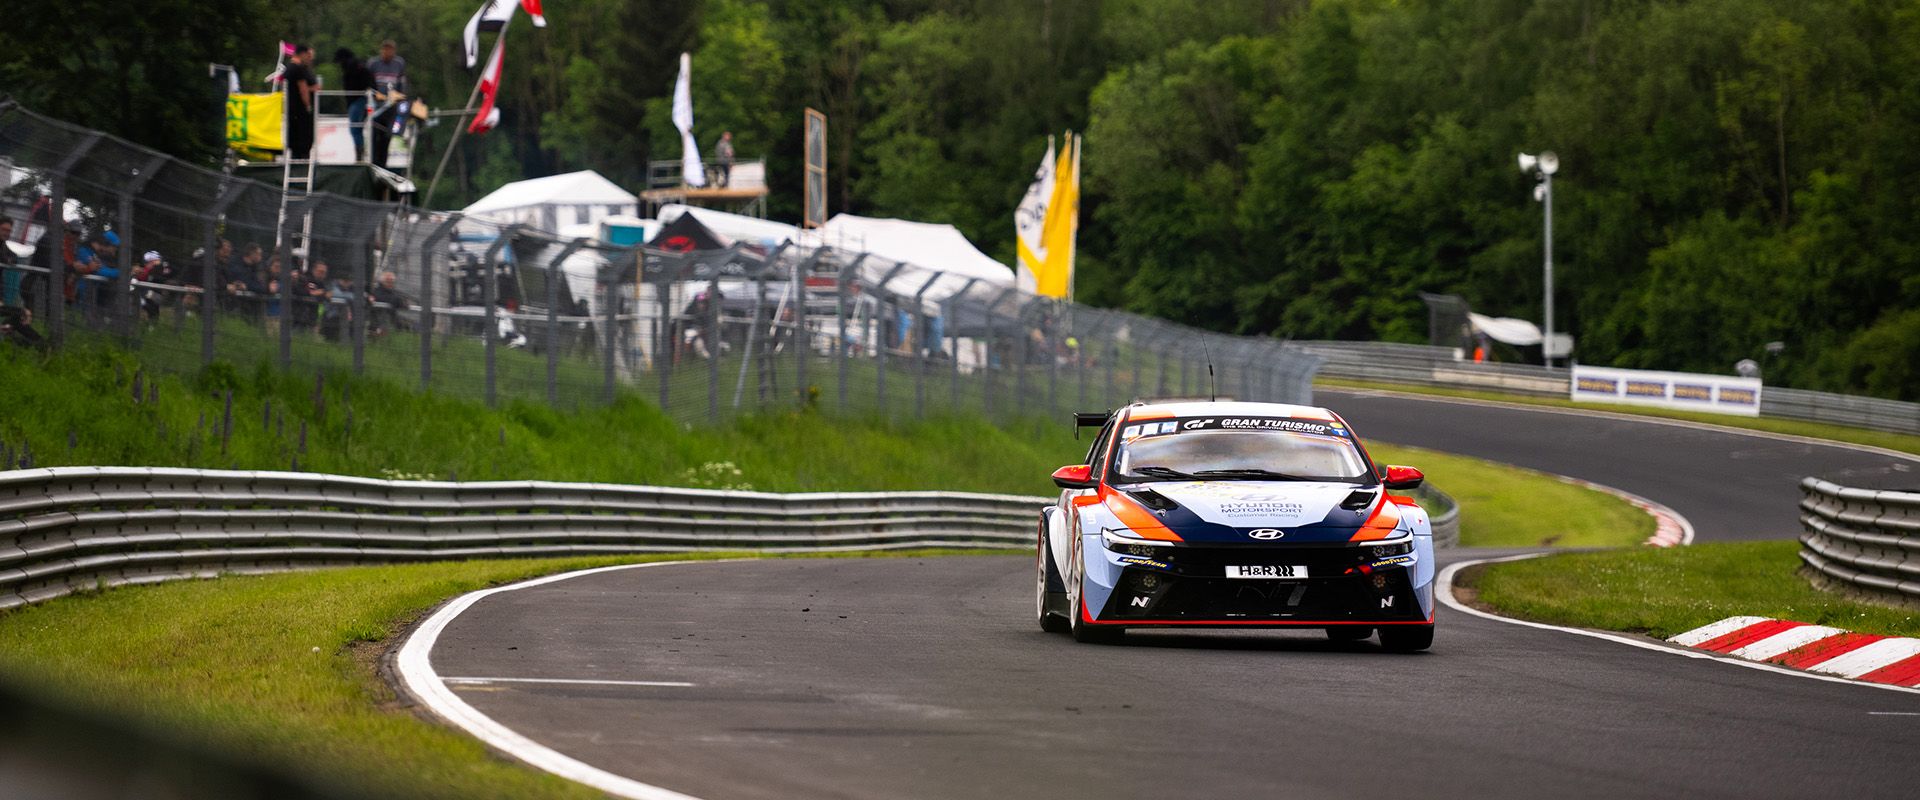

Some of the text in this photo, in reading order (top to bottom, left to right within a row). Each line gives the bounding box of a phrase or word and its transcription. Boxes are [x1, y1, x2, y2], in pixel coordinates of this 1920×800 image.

[1221, 418, 1325, 432] GRAN TURISMO
[1122, 558, 1167, 568] GOODYEAR
[1372, 557, 1409, 567] GOODYEAR
[1131, 596, 1150, 608] N
[1381, 595, 1394, 608] N
